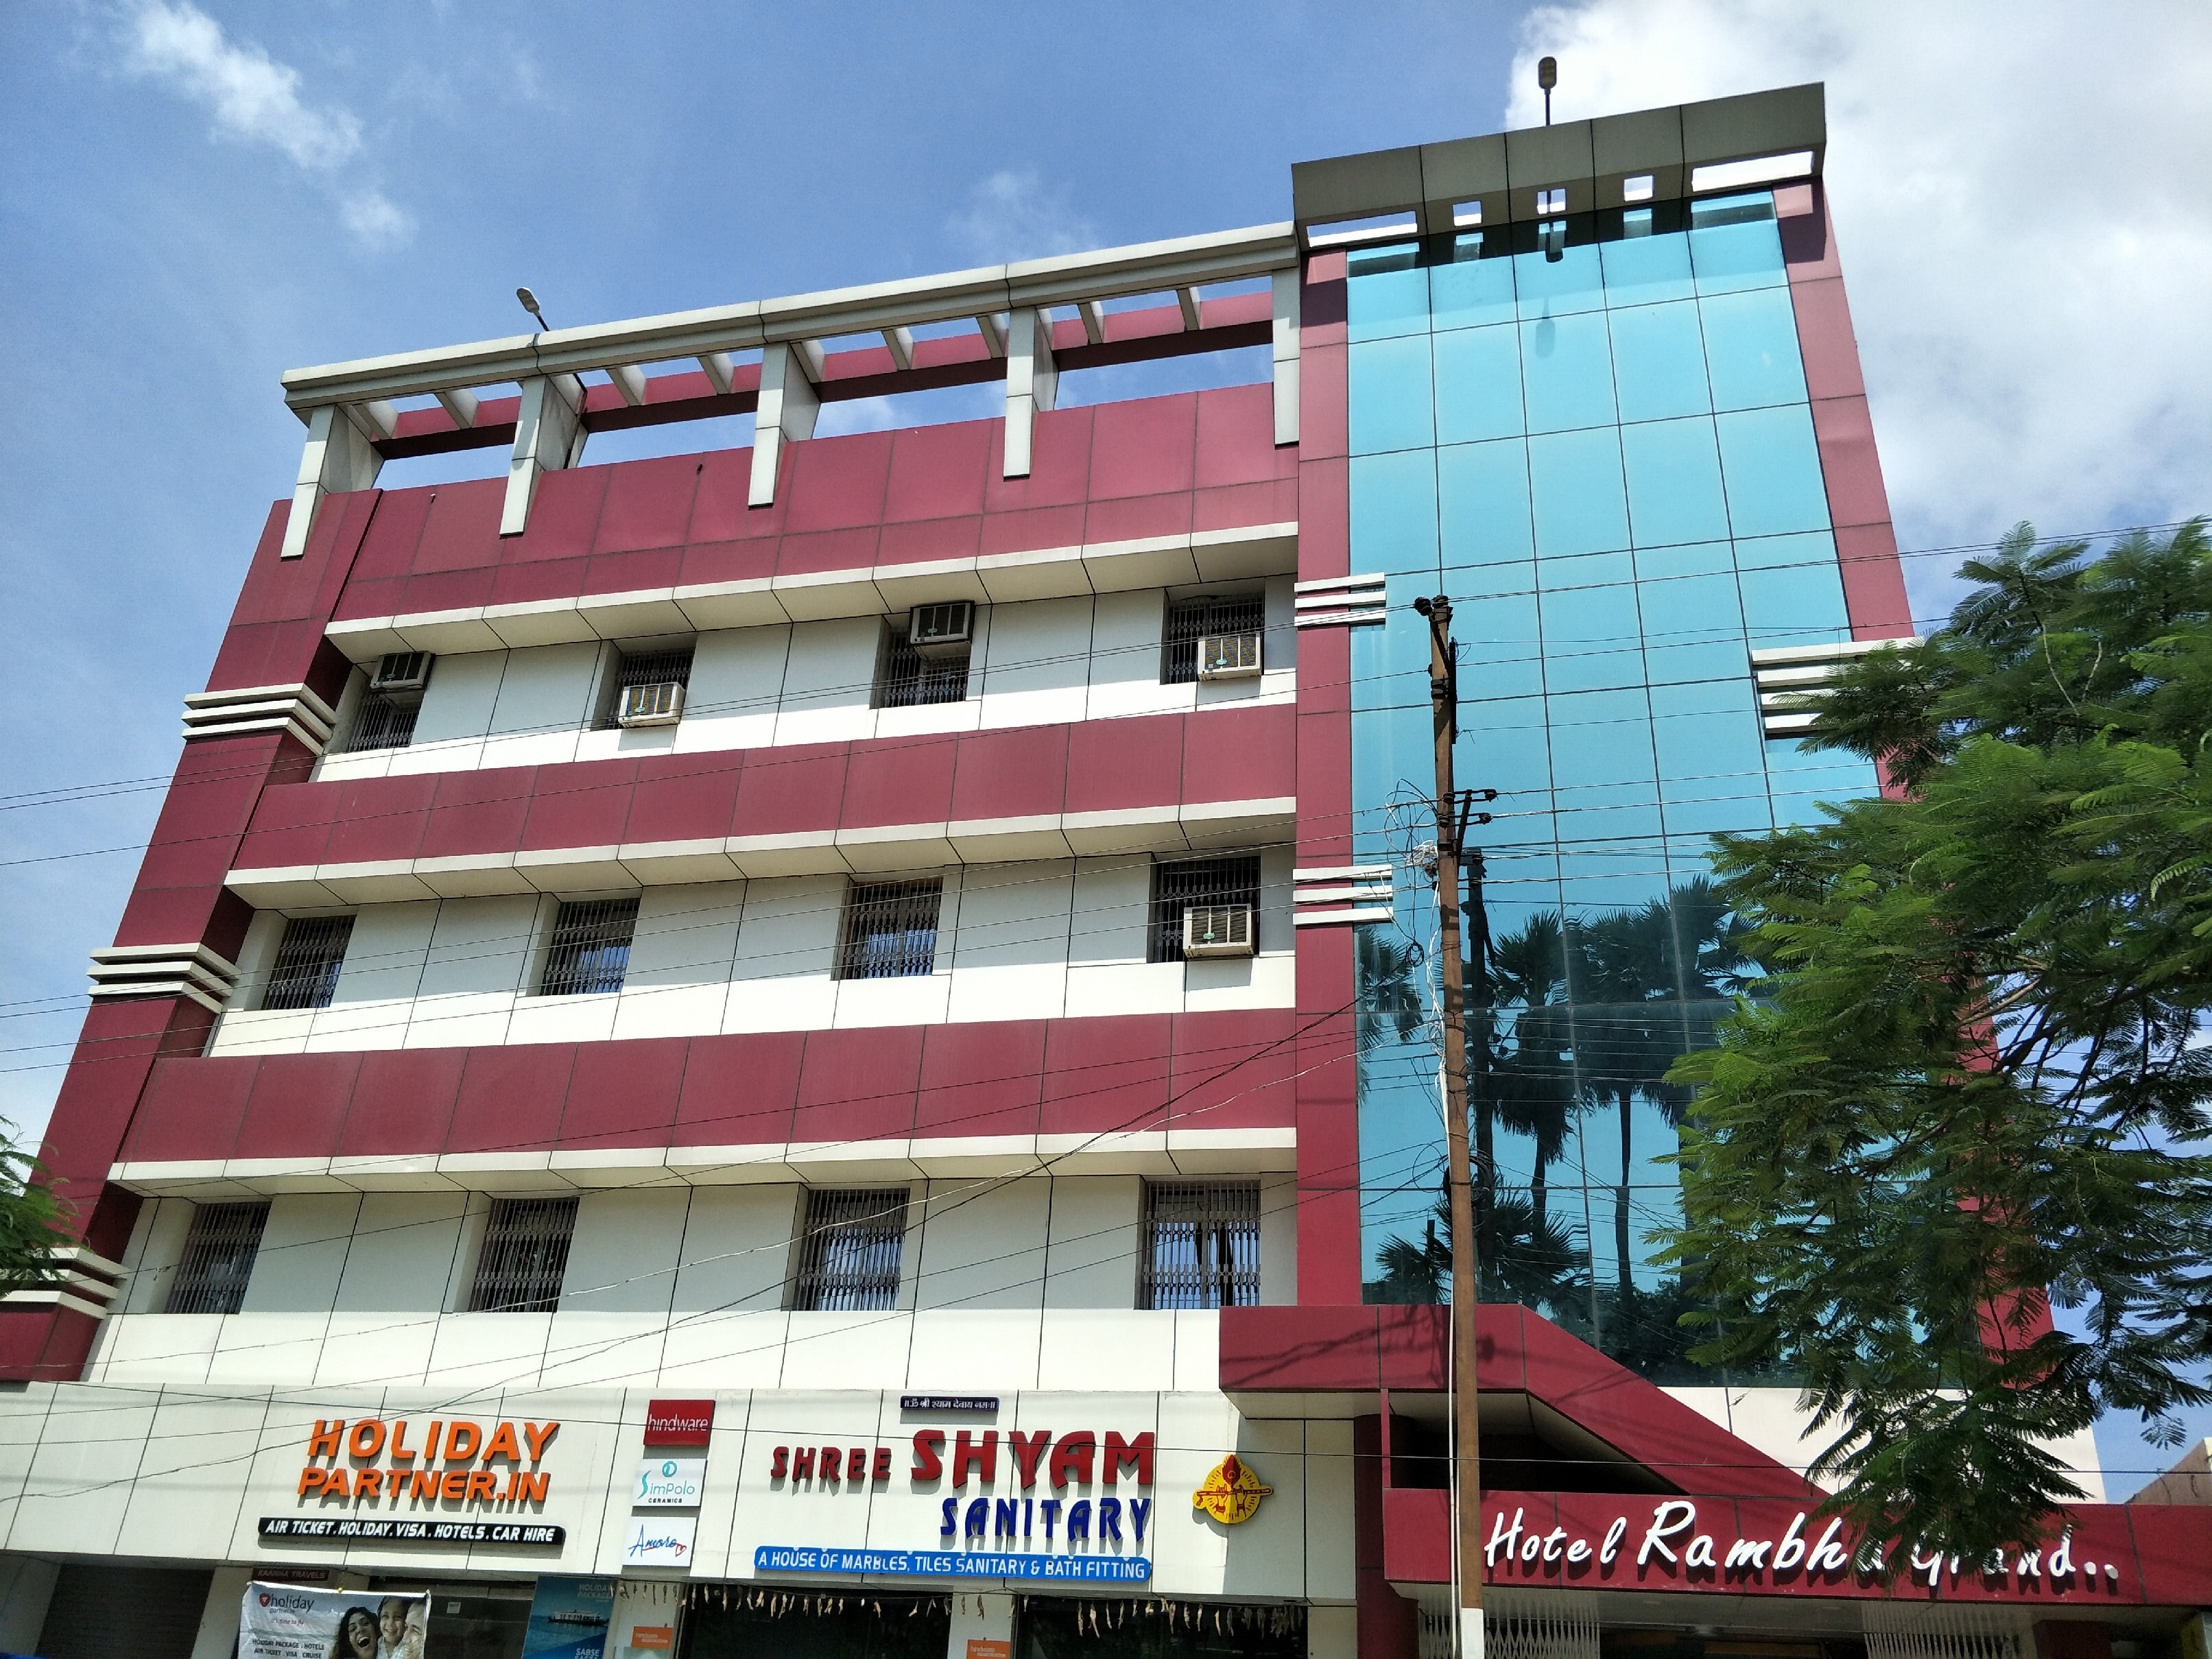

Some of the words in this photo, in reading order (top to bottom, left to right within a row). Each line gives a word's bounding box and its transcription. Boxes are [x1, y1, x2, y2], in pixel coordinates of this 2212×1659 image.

[647, 1413, 709, 1432] hindware
[307, 1418, 560, 1461] HOLIDAY
[770, 1446, 892, 1483] SHREE
[911, 1429, 1156, 1491] SHYAM
[297, 1467, 551, 1501] PARTNER.IN
[637, 1470, 695, 1500] SimPolo
[265, 1520, 289, 1533] AIR
[492, 1526, 521, 1541] CAR
[523, 1527, 556, 1542] HIRE
[940, 1497, 1152, 1542] SANITARY
[1484, 1507, 1628, 1568] Hotel
[291, 1571, 326, 1579] TRAVELS
[758, 1551, 768, 1566] A
[771, 1551, 817, 1568] HOUSE
[820, 1553, 839, 1569] OF
[914, 1556, 952, 1572] TILES
[955, 1557, 1027, 1575] SANITARY
[1031, 1560, 1040, 1575] &
[1045, 1561, 1082, 1577] BATH
[1086, 1561, 1145, 1579] FITTING
[271, 1593, 315, 1613] holiday
[275, 1640, 300, 1649] PACKAGE
[304, 1643, 324, 1651] HOTELS
